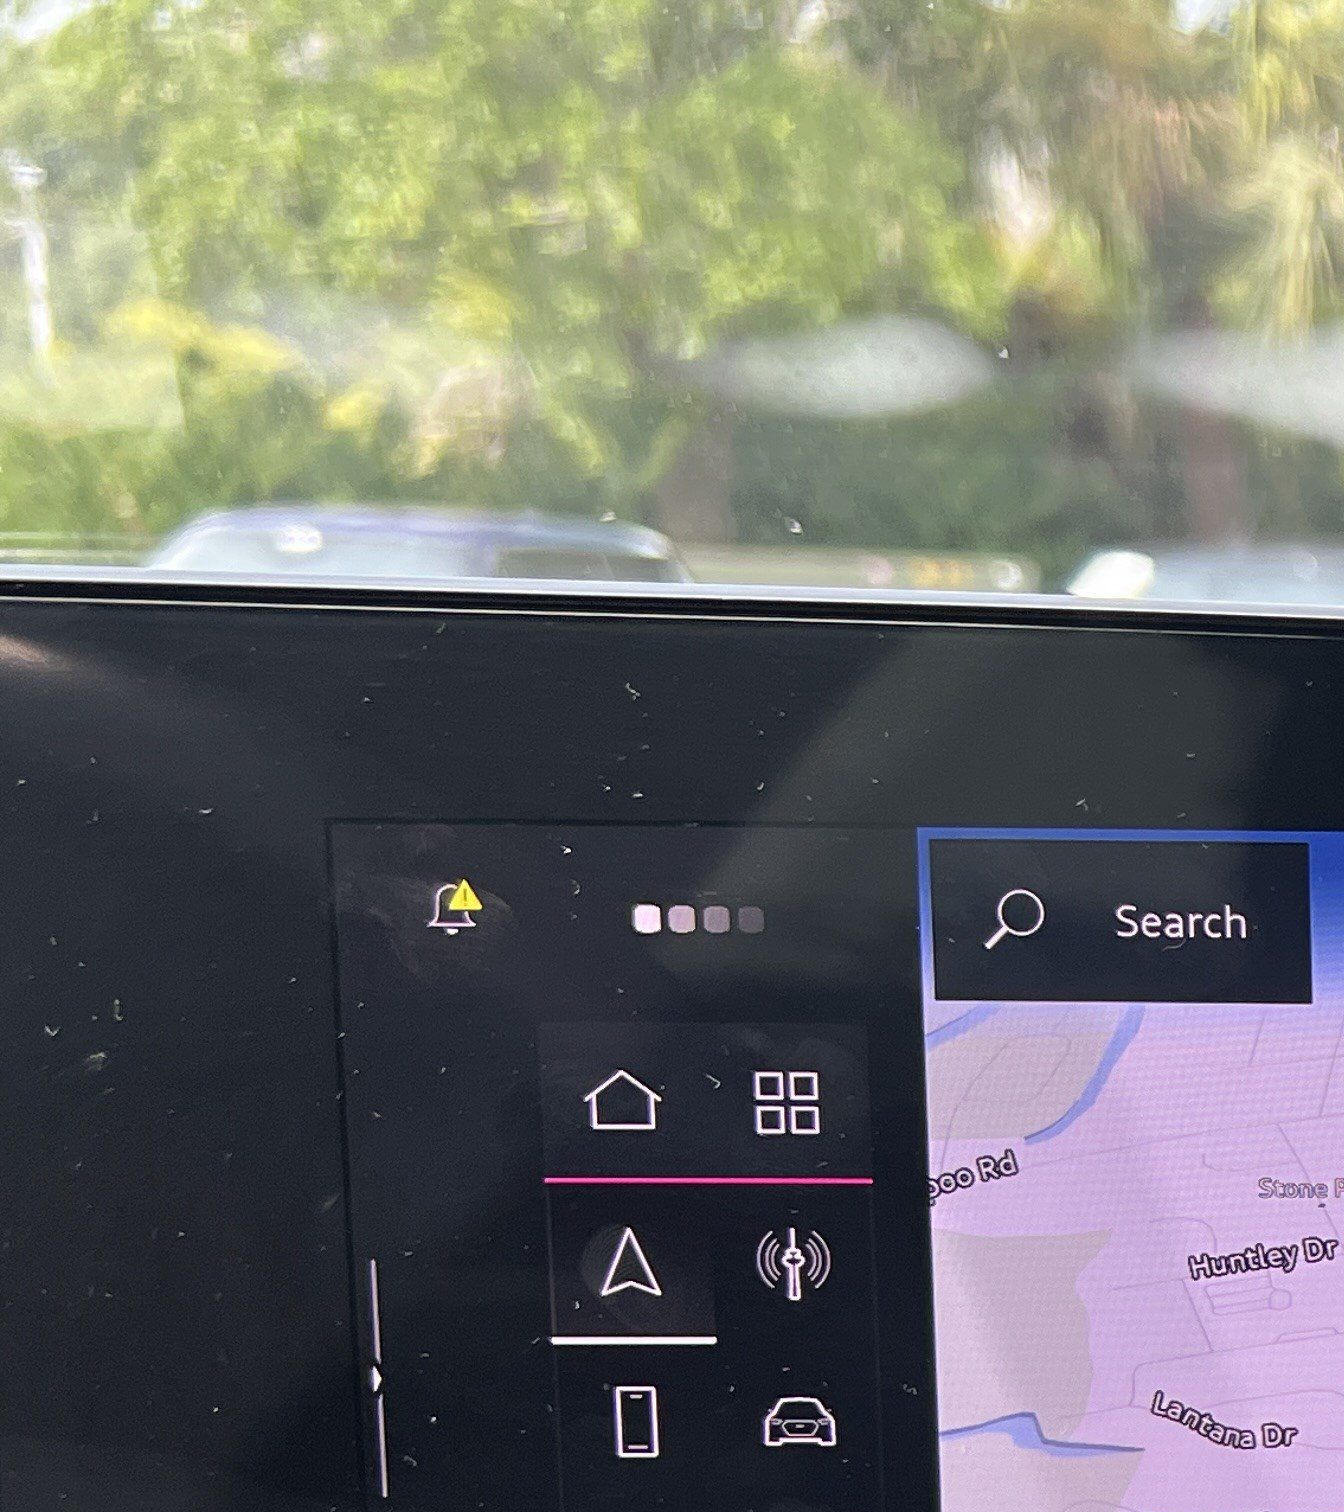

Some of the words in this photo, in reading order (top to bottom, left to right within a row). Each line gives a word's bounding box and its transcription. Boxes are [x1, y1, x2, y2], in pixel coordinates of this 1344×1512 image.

[1115, 903, 1247, 939] Search
[976, 1148, 1019, 1183] Rd
[1258, 1177, 1328, 1199] Stone
[1188, 1243, 1298, 1281] Huntley
[1302, 1236, 1339, 1262] Dr
[1151, 1390, 1256, 1450] Lantana
[1261, 1422, 1298, 1448] Dr
